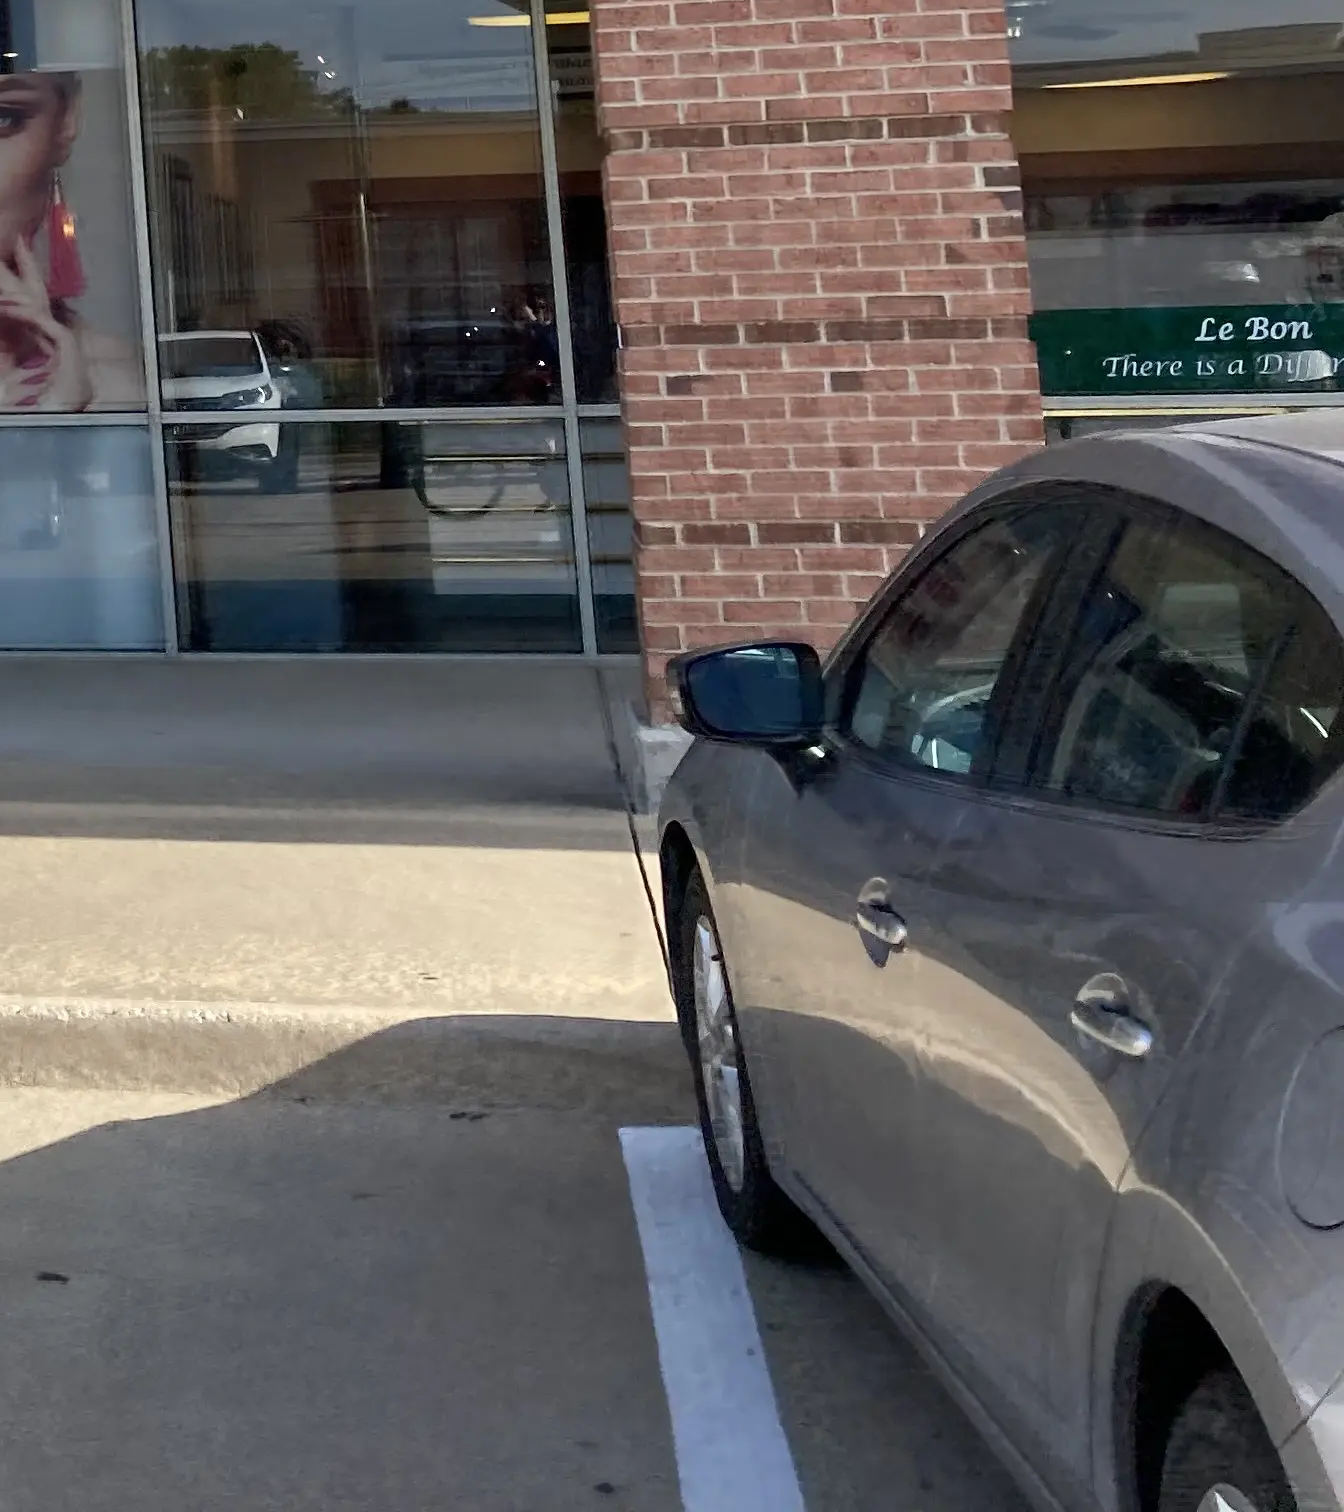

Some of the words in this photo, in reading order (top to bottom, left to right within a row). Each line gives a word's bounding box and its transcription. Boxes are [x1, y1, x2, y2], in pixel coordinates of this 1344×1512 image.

[1194, 317, 1234, 342] Le
[1244, 316, 1314, 341] Bon
[1102, 353, 1184, 378] There
[1196, 358, 1215, 376] is
[1227, 358, 1245, 375] a
[1256, 350, 1344, 383] Diffr
